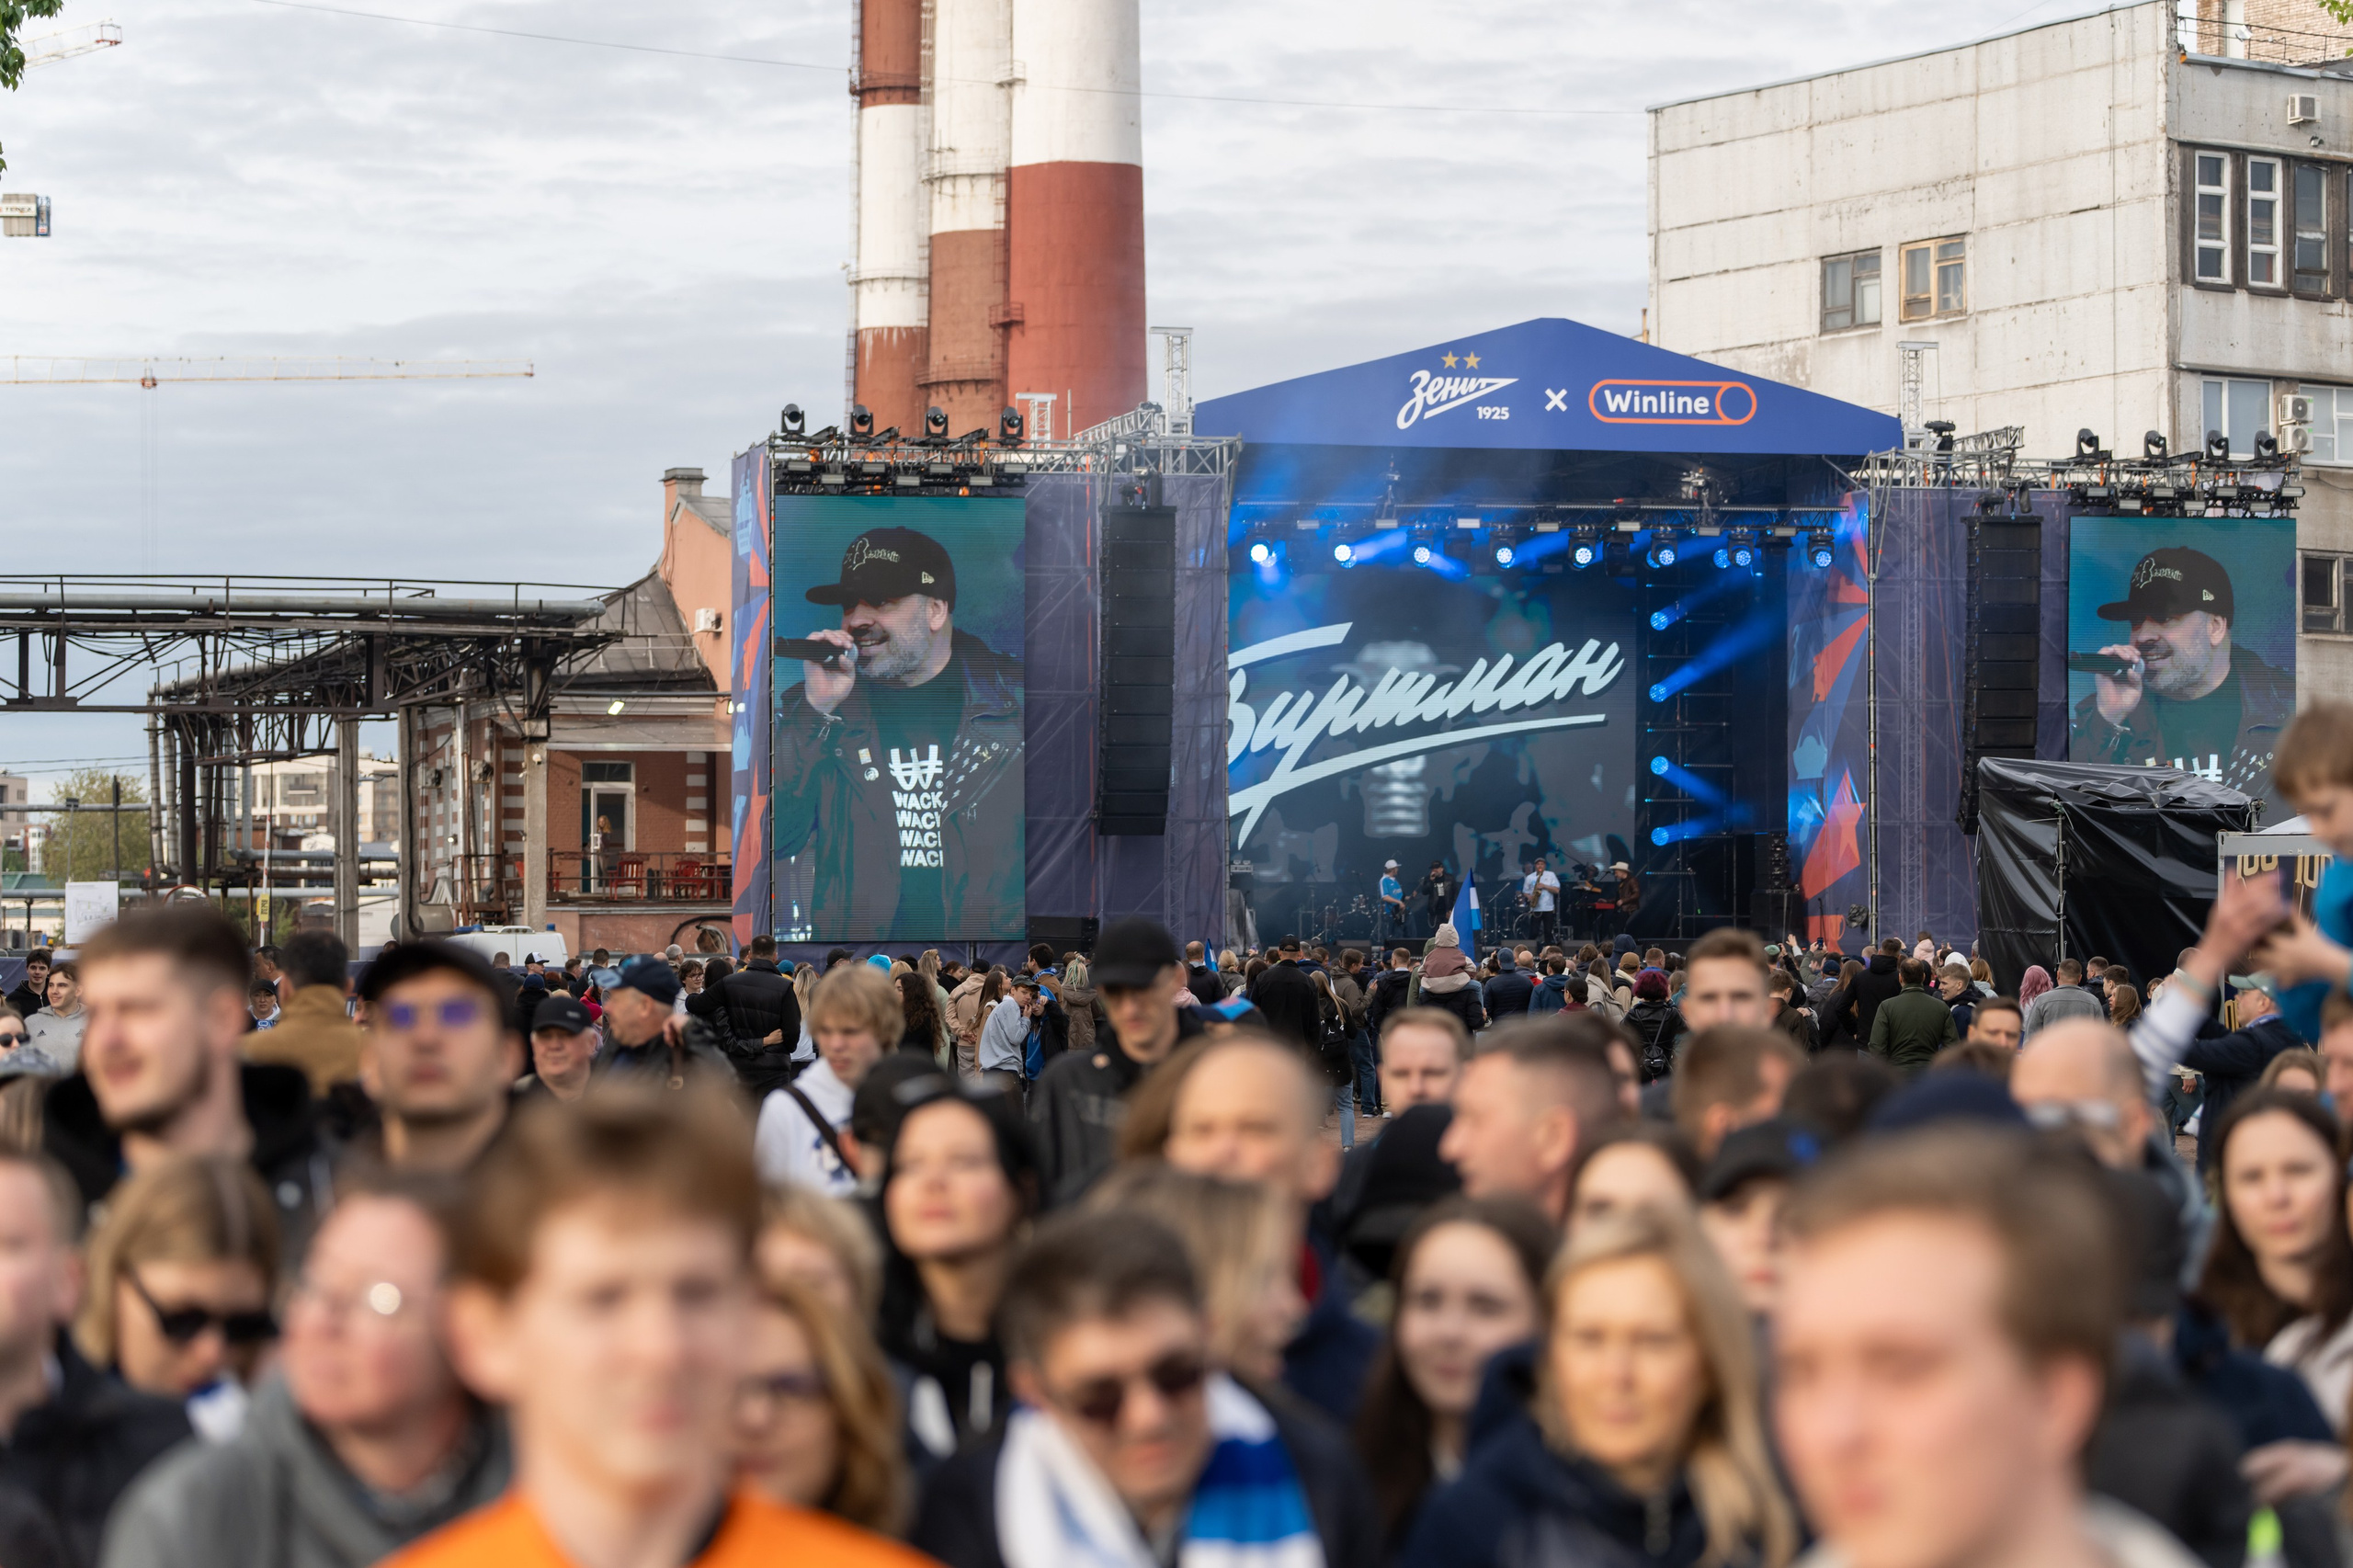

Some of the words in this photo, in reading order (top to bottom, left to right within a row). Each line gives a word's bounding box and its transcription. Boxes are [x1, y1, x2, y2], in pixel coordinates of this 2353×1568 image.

[1604, 390, 1710, 415] Winline
[1476, 405, 1509, 420] 1925
[892, 790, 944, 810] WACK
[899, 830, 942, 848] WAC
[901, 850, 944, 867] WAC
